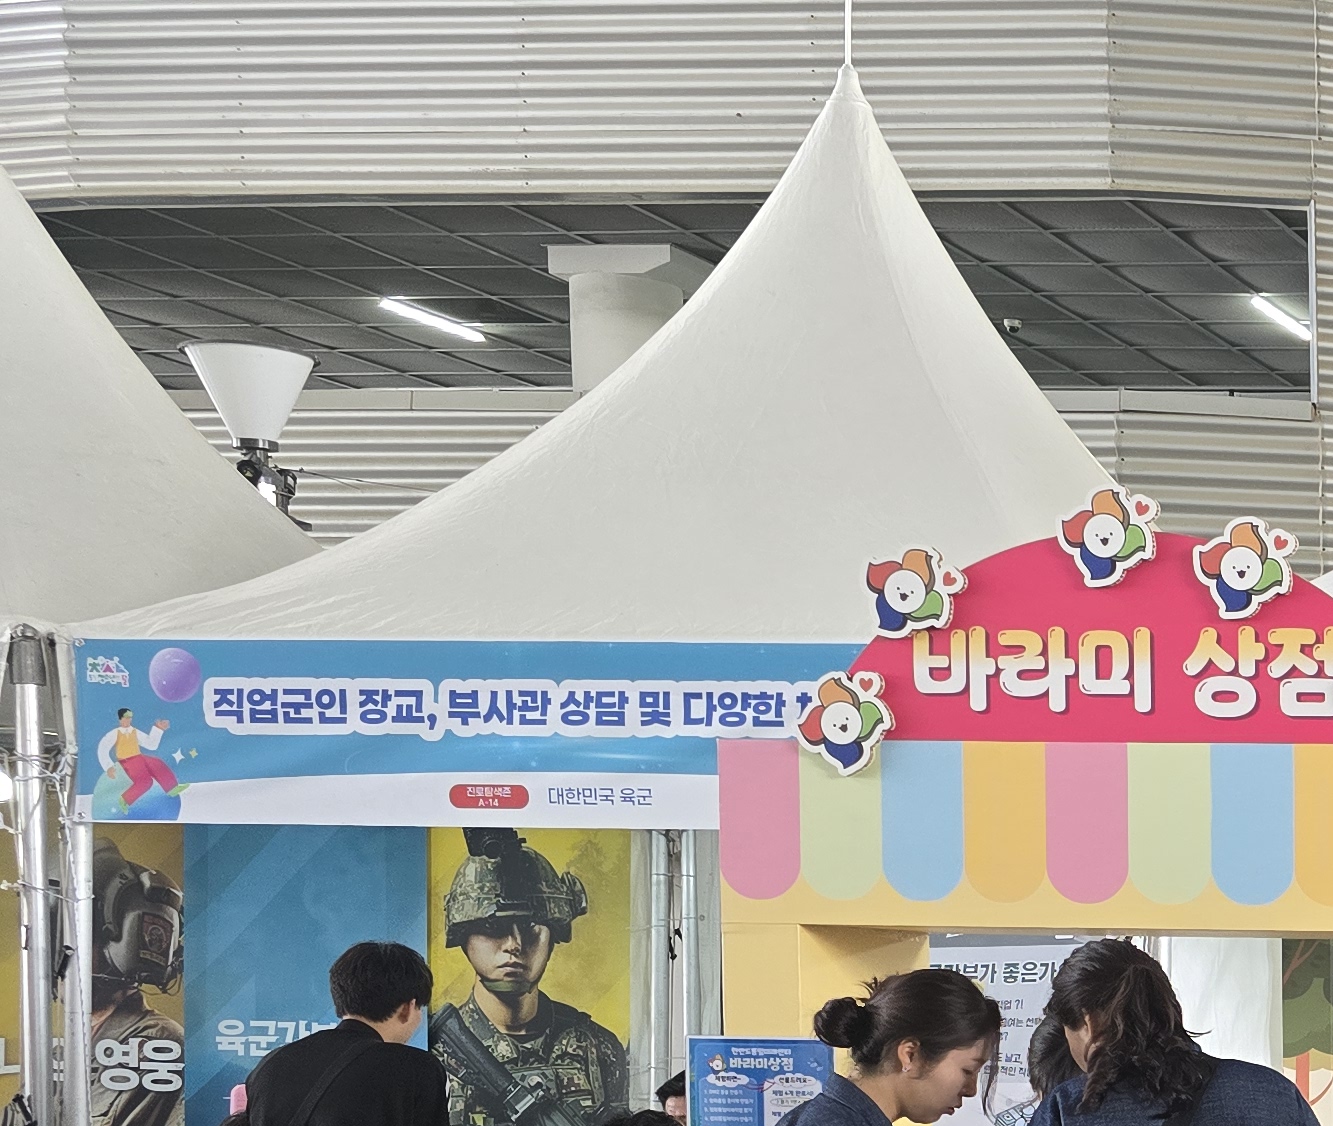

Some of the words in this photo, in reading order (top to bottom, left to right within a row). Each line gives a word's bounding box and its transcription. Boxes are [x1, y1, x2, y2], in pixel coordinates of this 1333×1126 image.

[912, 625, 1153, 713] 바라미
[213, 688, 348, 725] 직업군인
[358, 689, 438, 731] 장교,
[447, 689, 552, 726] 부사관
[559, 690, 629, 727] 상담
[638, 690, 672, 728] 및
[682, 691, 786, 728] 다양한
[466, 786, 512, 797] 진로탐색존
[548, 787, 616, 806] 대한민국
[619, 787, 653, 806] 육군
[478, 799, 499, 808] A-14
[930, 963, 997, 984] 부가
[95, 1037, 185, 1092] 영웅
[729, 1057, 794, 1071] 바라미상점
